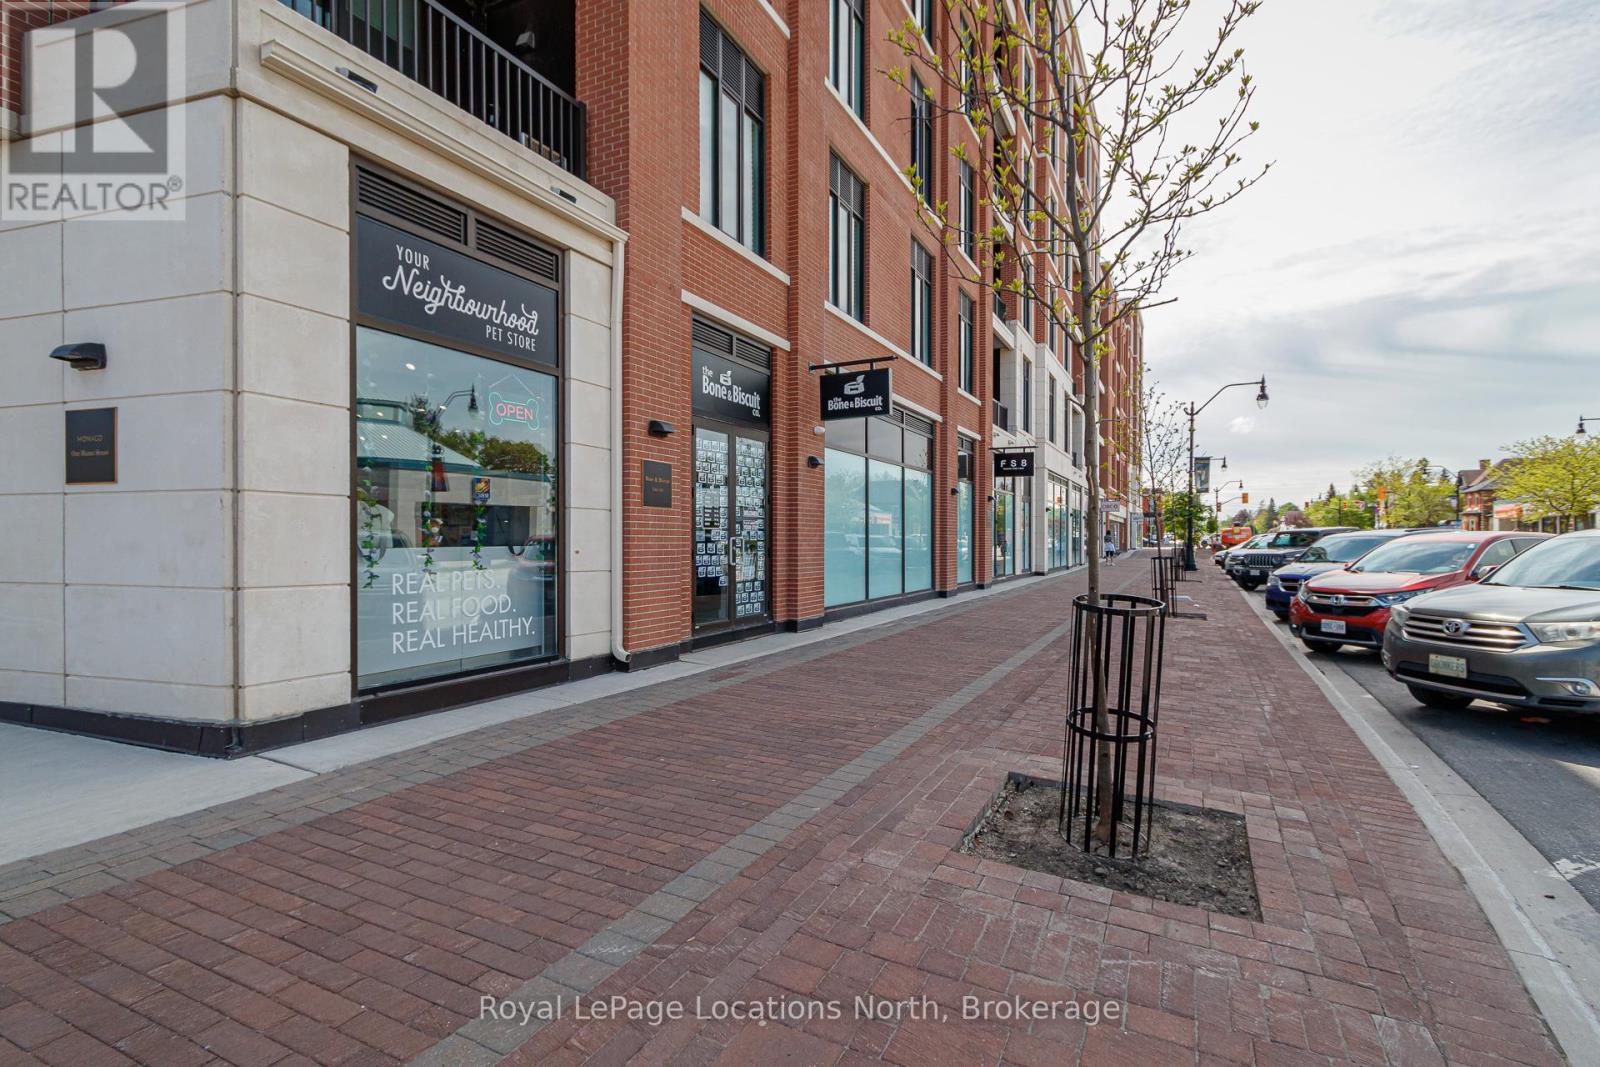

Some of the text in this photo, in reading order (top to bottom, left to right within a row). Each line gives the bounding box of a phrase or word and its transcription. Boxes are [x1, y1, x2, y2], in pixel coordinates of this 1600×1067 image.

[396, 244, 430, 271] YOUR
[382, 265, 539, 336] Neighbourhood
[486, 325, 536, 352] PET STORE
[702, 365, 713, 377] the
[702, 375, 727, 400] Bone
[732, 385, 760, 410] Biscuit
[828, 399, 849, 411] Bone
[854, 395, 883, 409] Biscuit
[496, 402, 534, 420] OPEN
[392, 570, 500, 595] REAL PETS.
[392, 594, 516, 625] REAL FOOD.
[392, 616, 536, 654] REAL HEALTHY.
